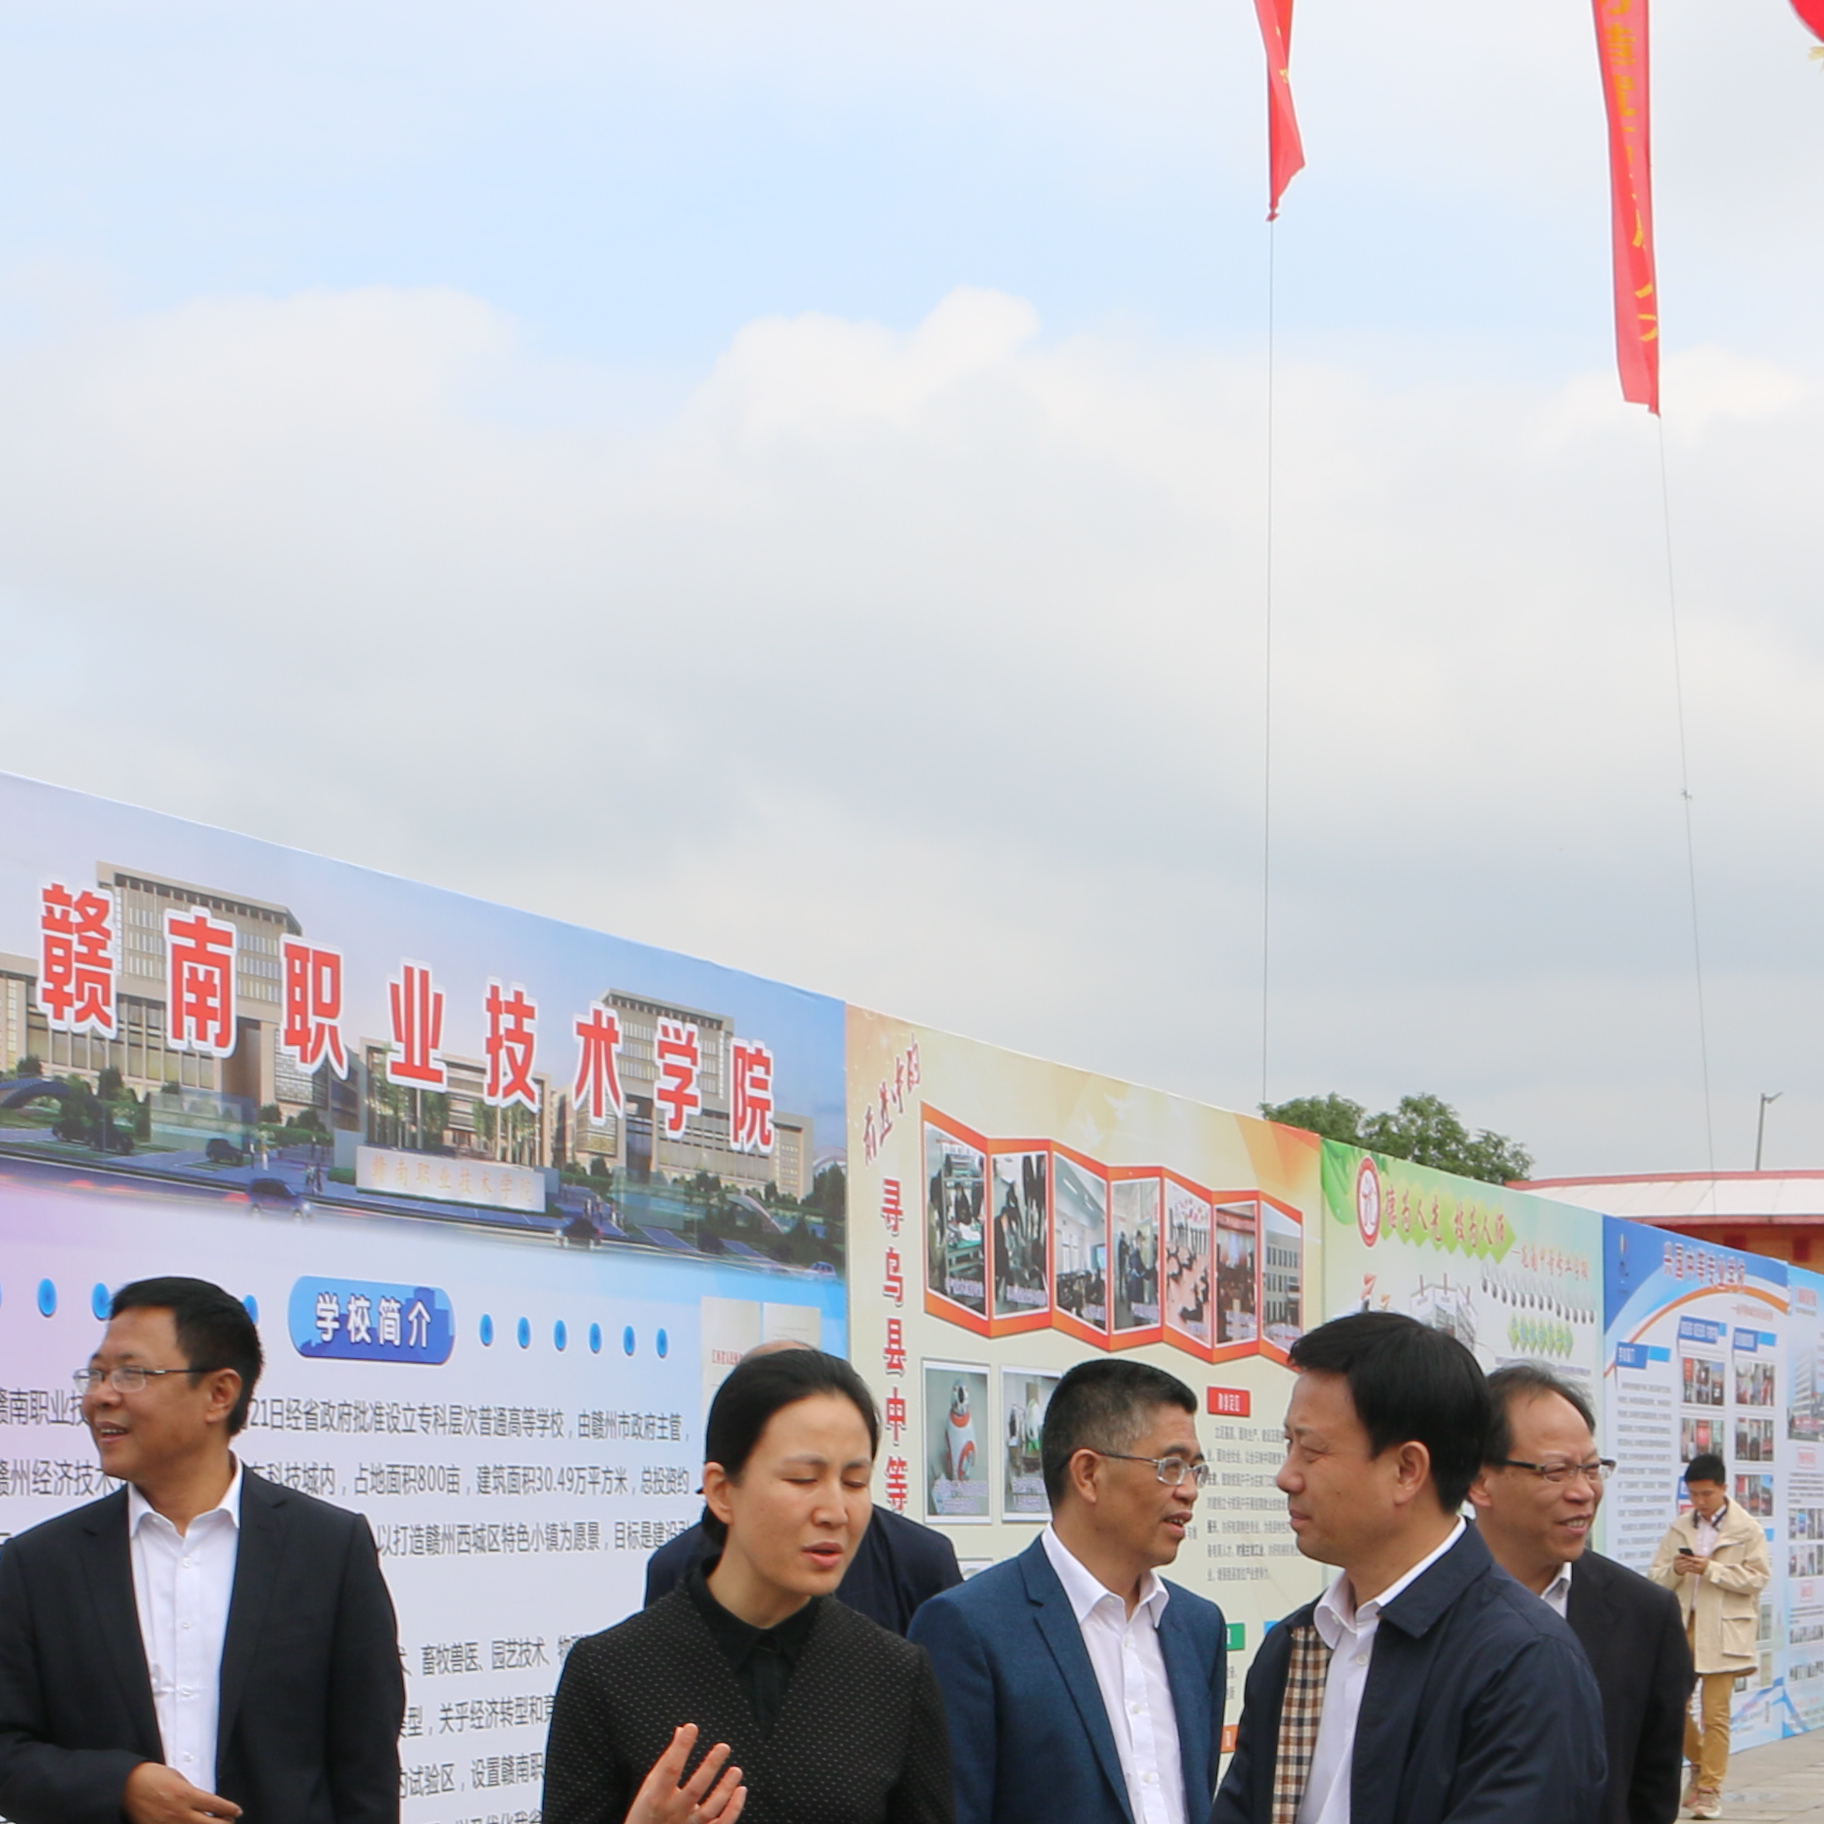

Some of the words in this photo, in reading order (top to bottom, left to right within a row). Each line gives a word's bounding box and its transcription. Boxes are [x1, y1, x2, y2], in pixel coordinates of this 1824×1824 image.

[39, 882, 776, 1150] 赣南职业技术学院
[315, 1292, 434, 1349] 学校简介
